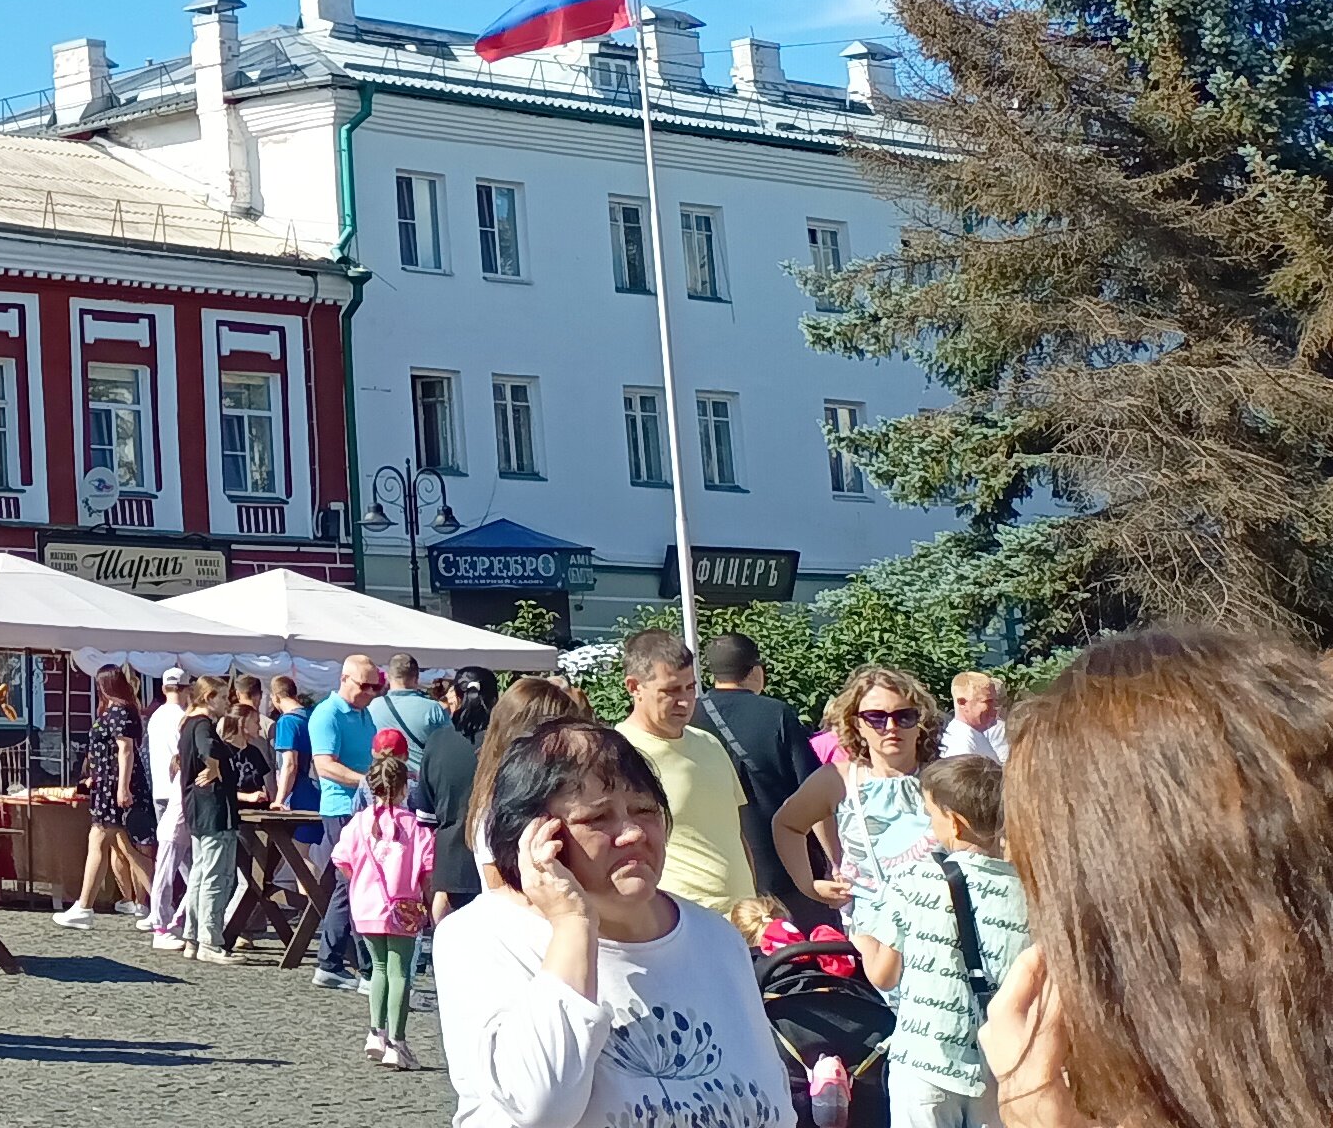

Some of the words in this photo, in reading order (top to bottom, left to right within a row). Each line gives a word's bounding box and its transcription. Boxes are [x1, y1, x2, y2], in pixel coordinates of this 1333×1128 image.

[82, 549, 183, 590] Шармъ
[437, 553, 556, 577] СЕРЕБРО
[695, 557, 779, 587] ФИЦЕРЪ
[921, 870, 1009, 899] woerful
